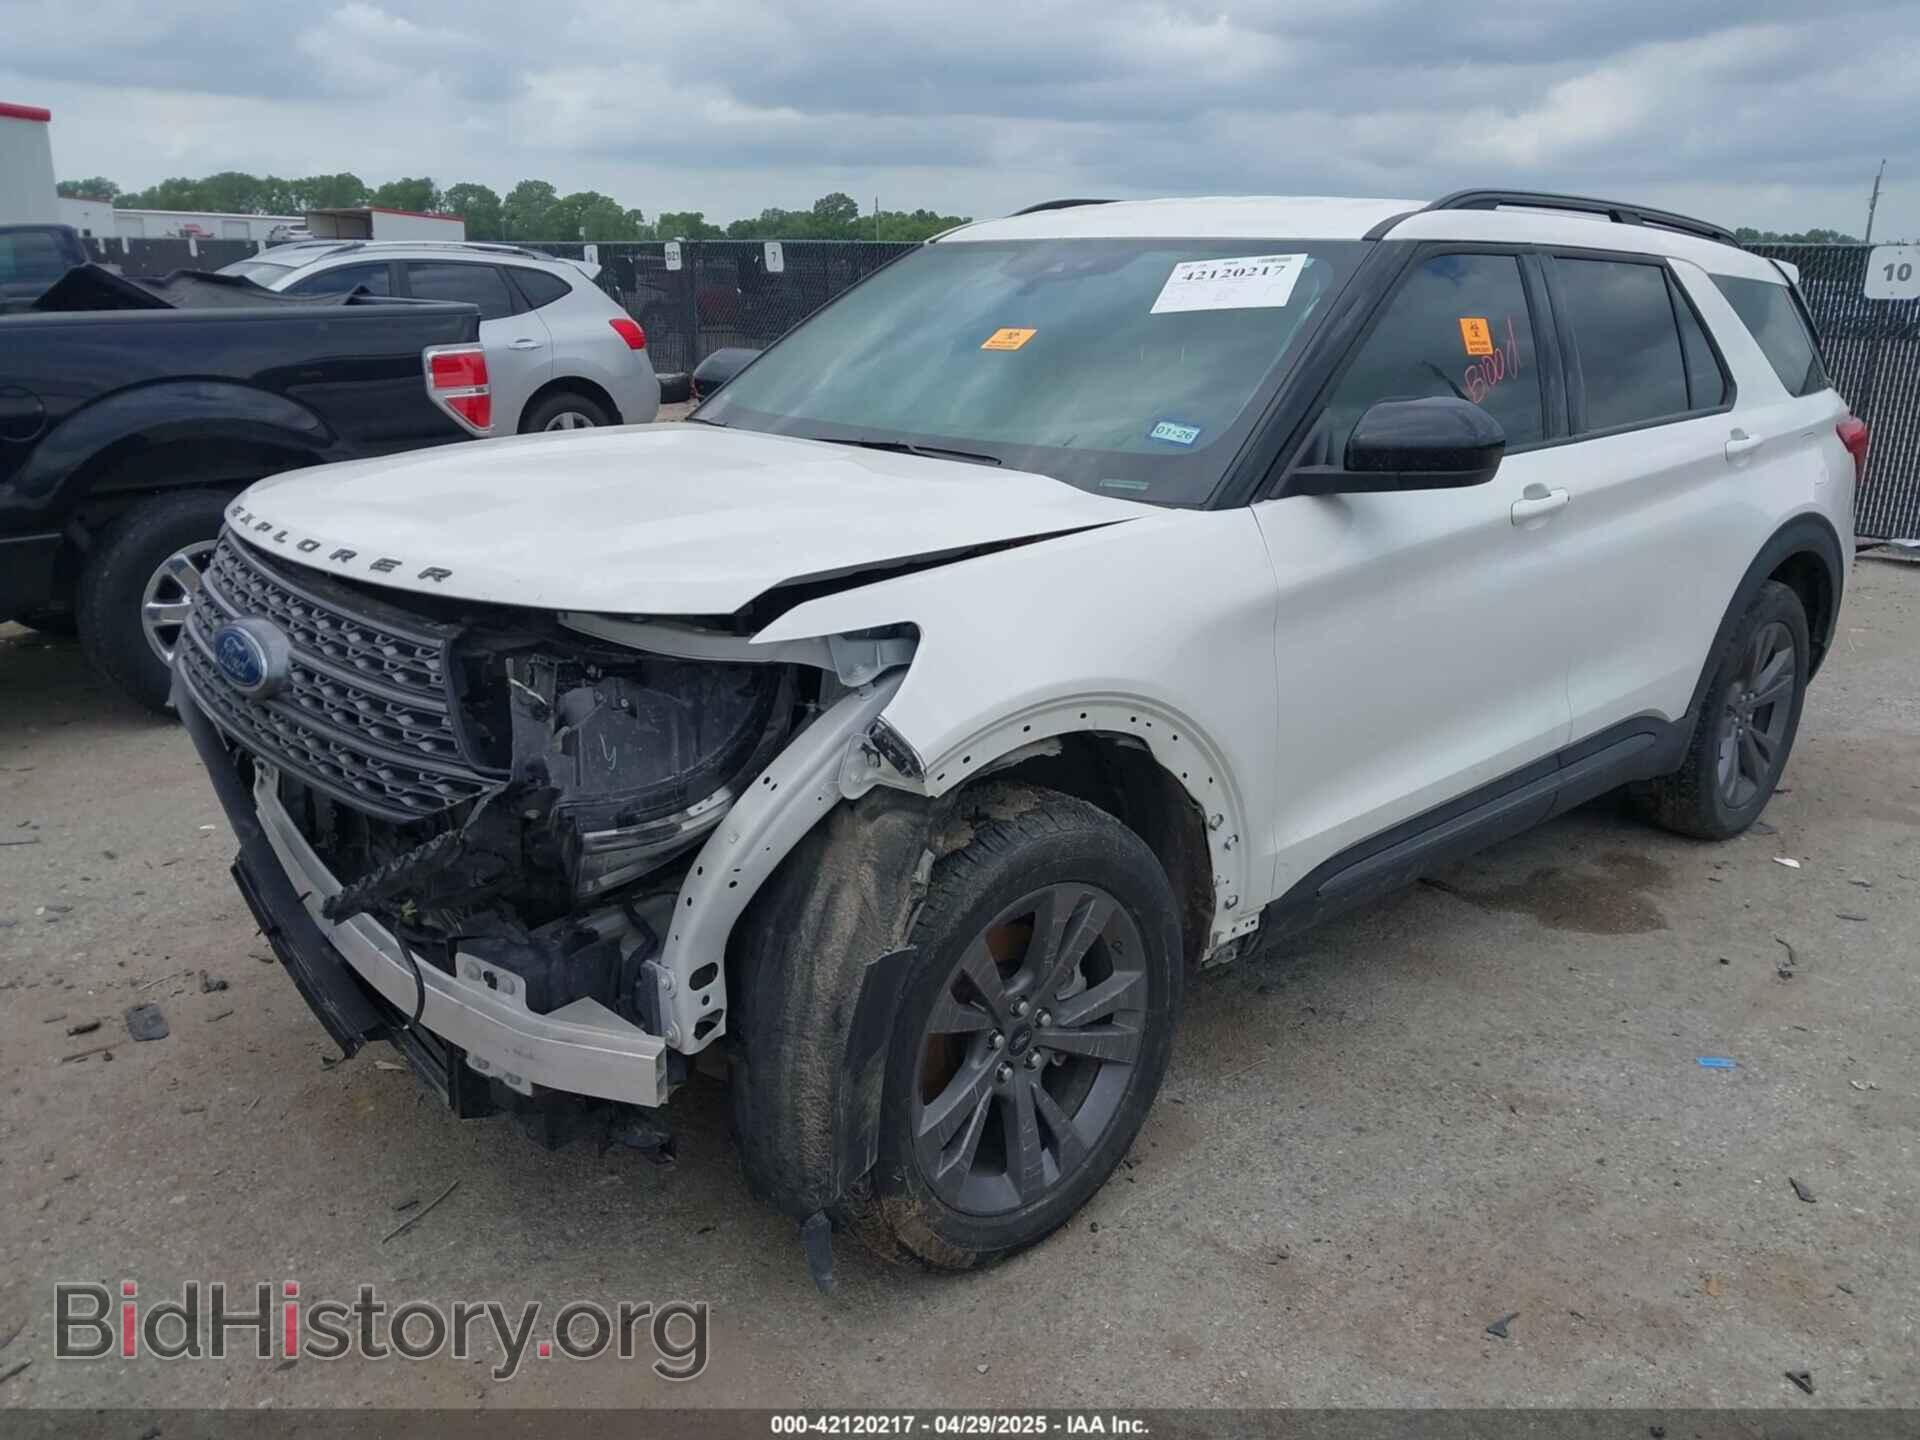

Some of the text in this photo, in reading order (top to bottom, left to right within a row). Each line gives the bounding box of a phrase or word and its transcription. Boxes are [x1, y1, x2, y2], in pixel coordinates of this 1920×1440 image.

[771, 251, 778, 264] 7
[1181, 264, 1287, 281] 42120217
[1882, 262, 1913, 282] 10
[230, 504, 453, 583] EXPLORER
